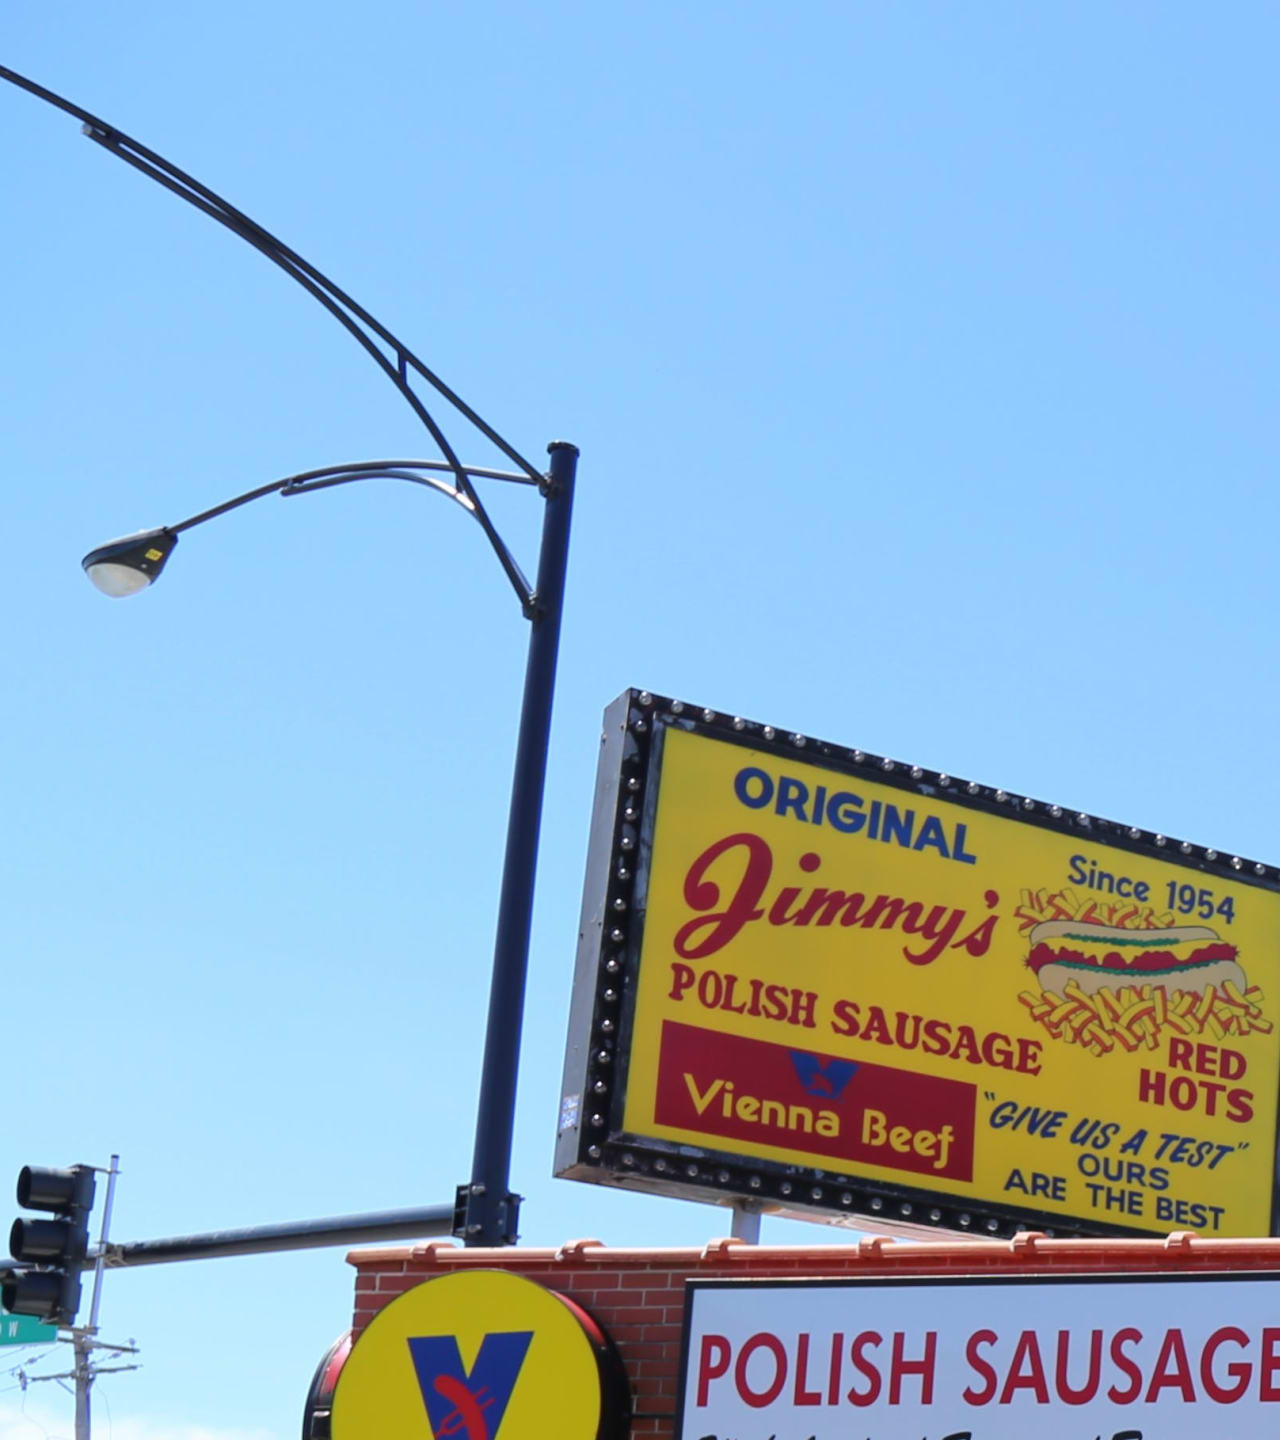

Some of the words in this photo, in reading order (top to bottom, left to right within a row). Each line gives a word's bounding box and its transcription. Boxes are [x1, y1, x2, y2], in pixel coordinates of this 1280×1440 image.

[732, 766, 977, 866] ORIGINAL
[672, 832, 1000, 967] Jimmy's
[1067, 853, 1149, 903] Since
[1166, 880, 1236, 925] 1954
[668, 962, 818, 1030] POLISH
[831, 1001, 1043, 1077] SAUSAGE
[1167, 1036, 1247, 1080] RED
[683, 1072, 841, 1139] Vienna
[860, 1108, 955, 1168] Beef
[1138, 1067, 1255, 1124] HOTS
[1069, 1117, 1120, 1150] US
[1119, 1128, 1149, 1156] A
[1077, 1153, 1170, 1191] OURS
[1003, 1168, 1067, 1201] ARE
[1085, 1182, 1144, 1216] THE
[1155, 1196, 1225, 1230] BEST
[696, 1331, 939, 1409] POLISH
